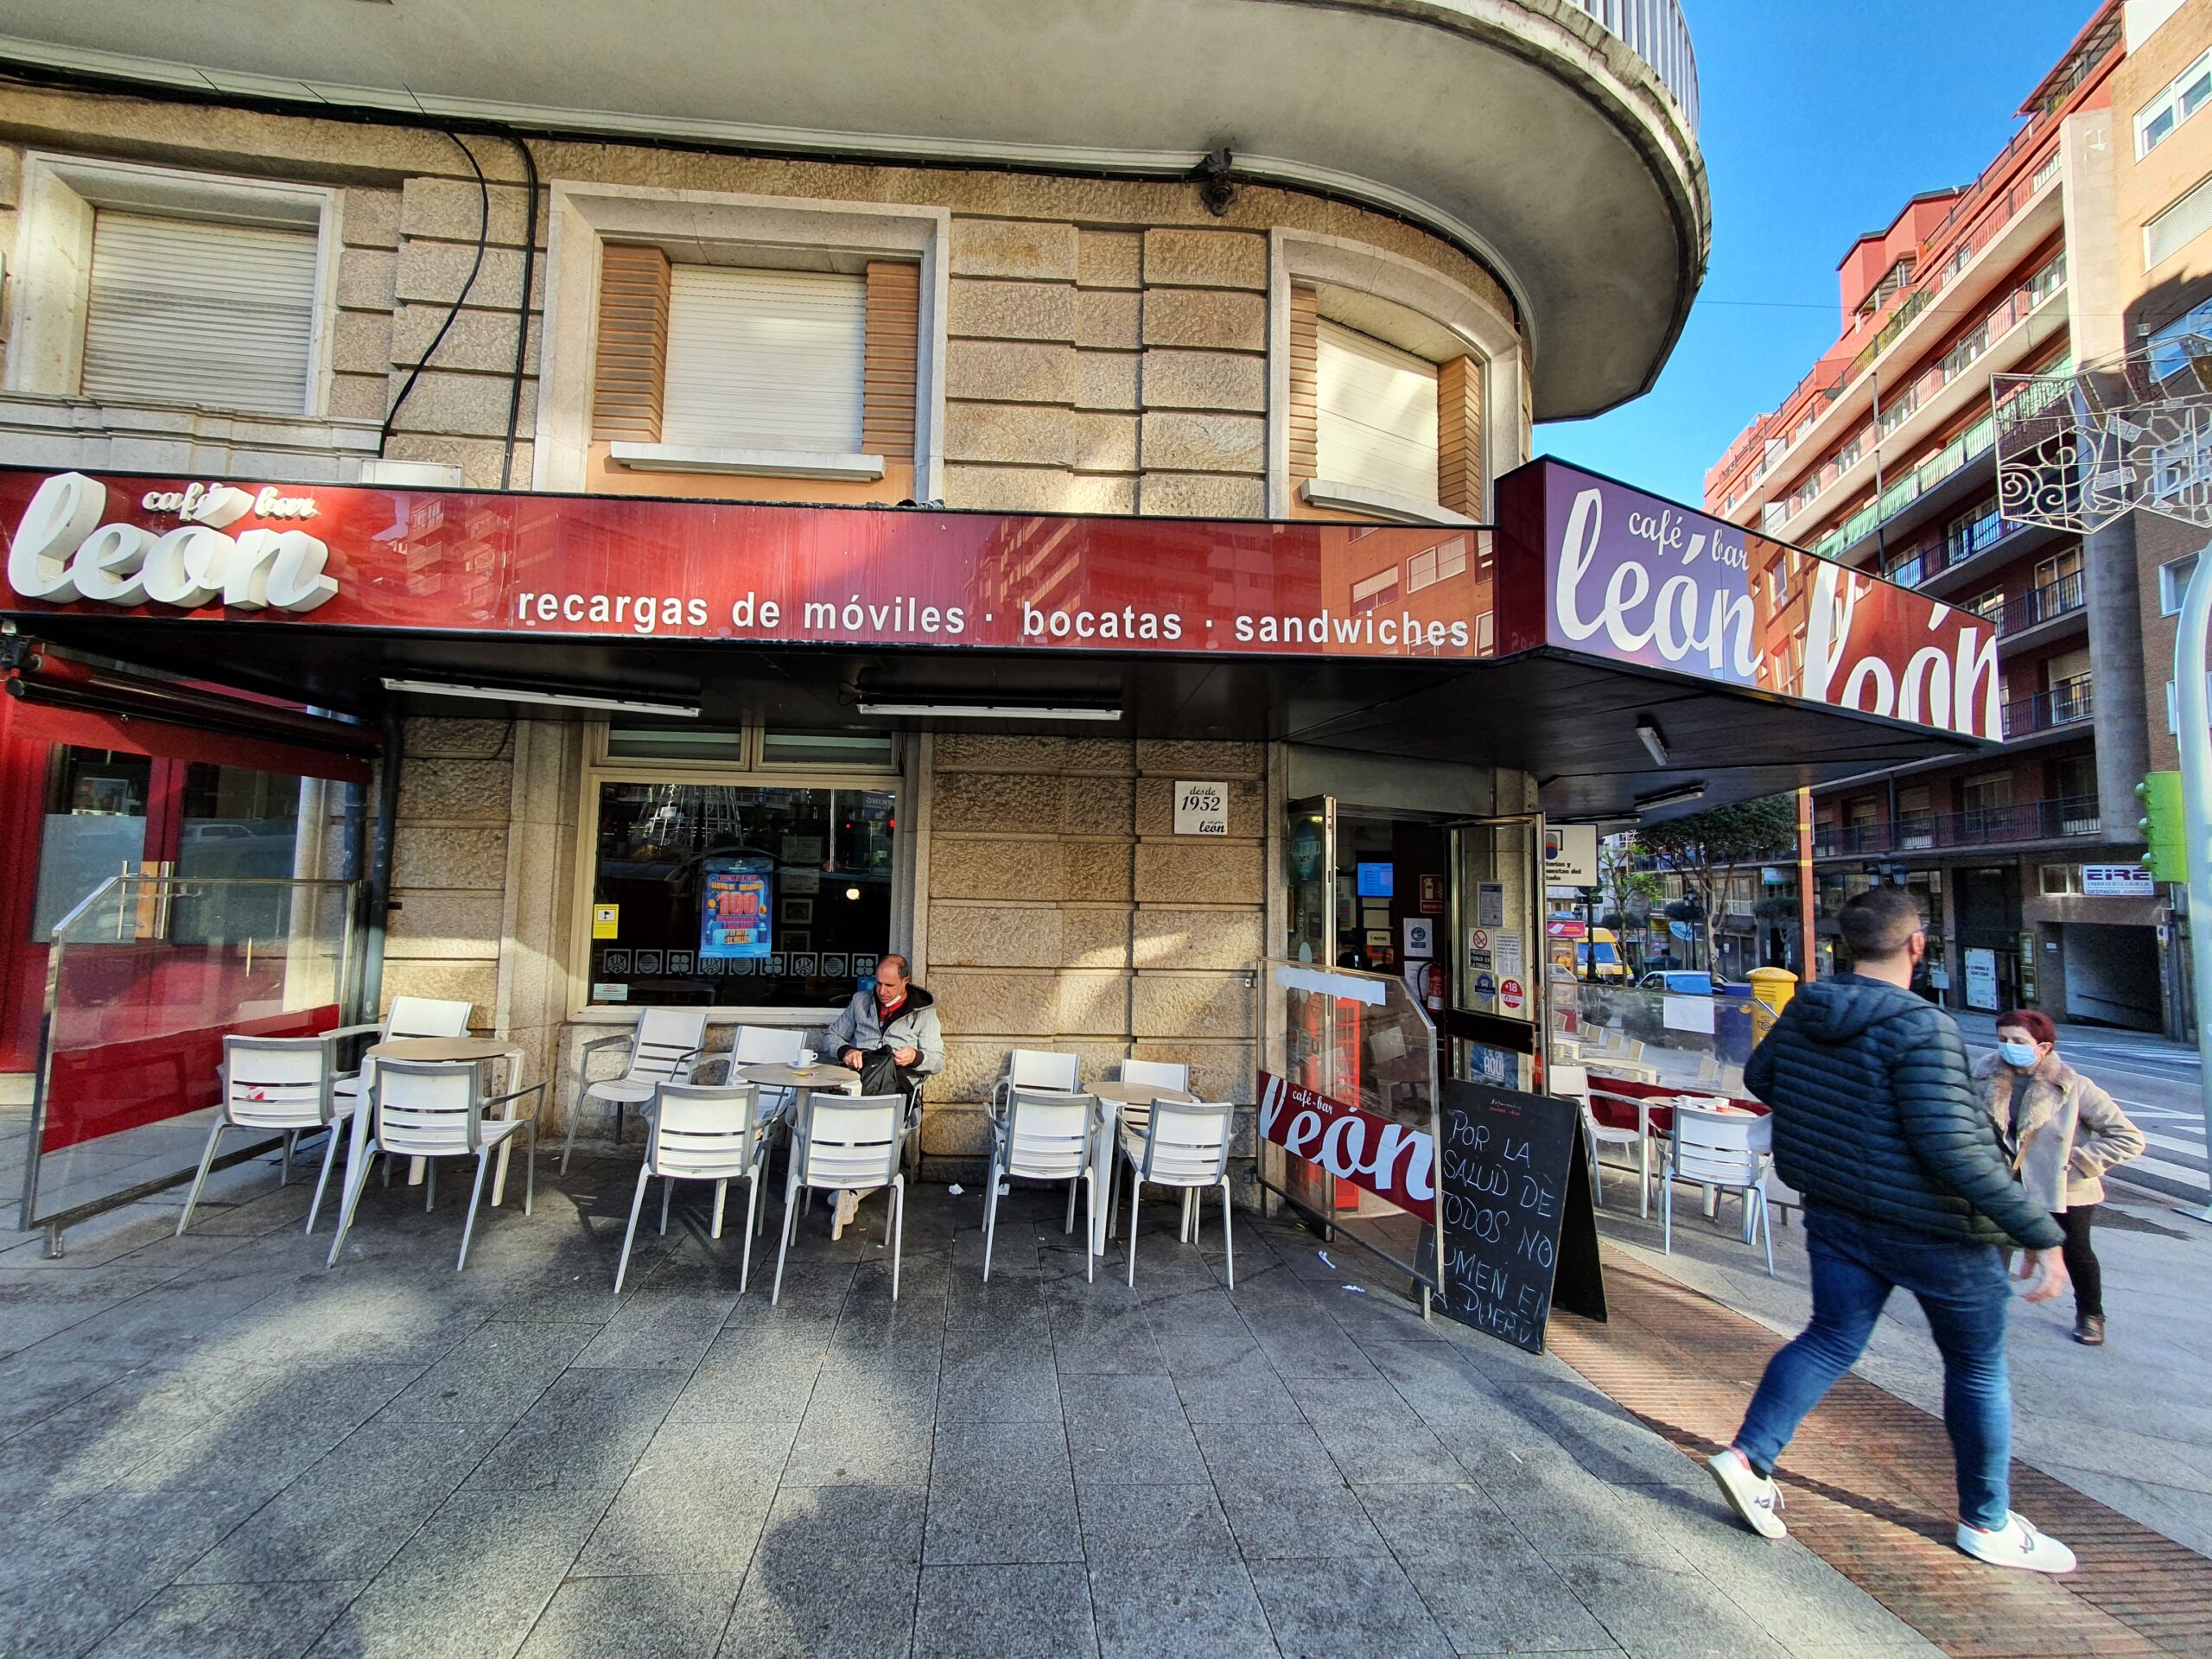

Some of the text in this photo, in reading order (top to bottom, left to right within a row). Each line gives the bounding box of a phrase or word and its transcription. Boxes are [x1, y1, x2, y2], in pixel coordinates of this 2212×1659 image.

[254, 486, 321, 518] bar
[8, 472, 338, 611] león
[1628, 509, 1750, 571] café bar
[1556, 487, 1764, 677] león
[518, 593, 708, 633] recargas
[733, 592, 780, 627] de
[804, 594, 965, 633] móviles
[1023, 601, 1183, 639] bocatas
[1235, 609, 1469, 647] sandwiches
[1182, 796, 1220, 811] 1952
[1190, 786, 1216, 796] desde
[1198, 820, 1225, 833] león
[717, 891, 758, 916] 100
[1447, 1109, 1530, 1168] POR LA
[1443, 1149, 1554, 1217] SALUD DE
[1517, 1225, 1553, 1268] NO
